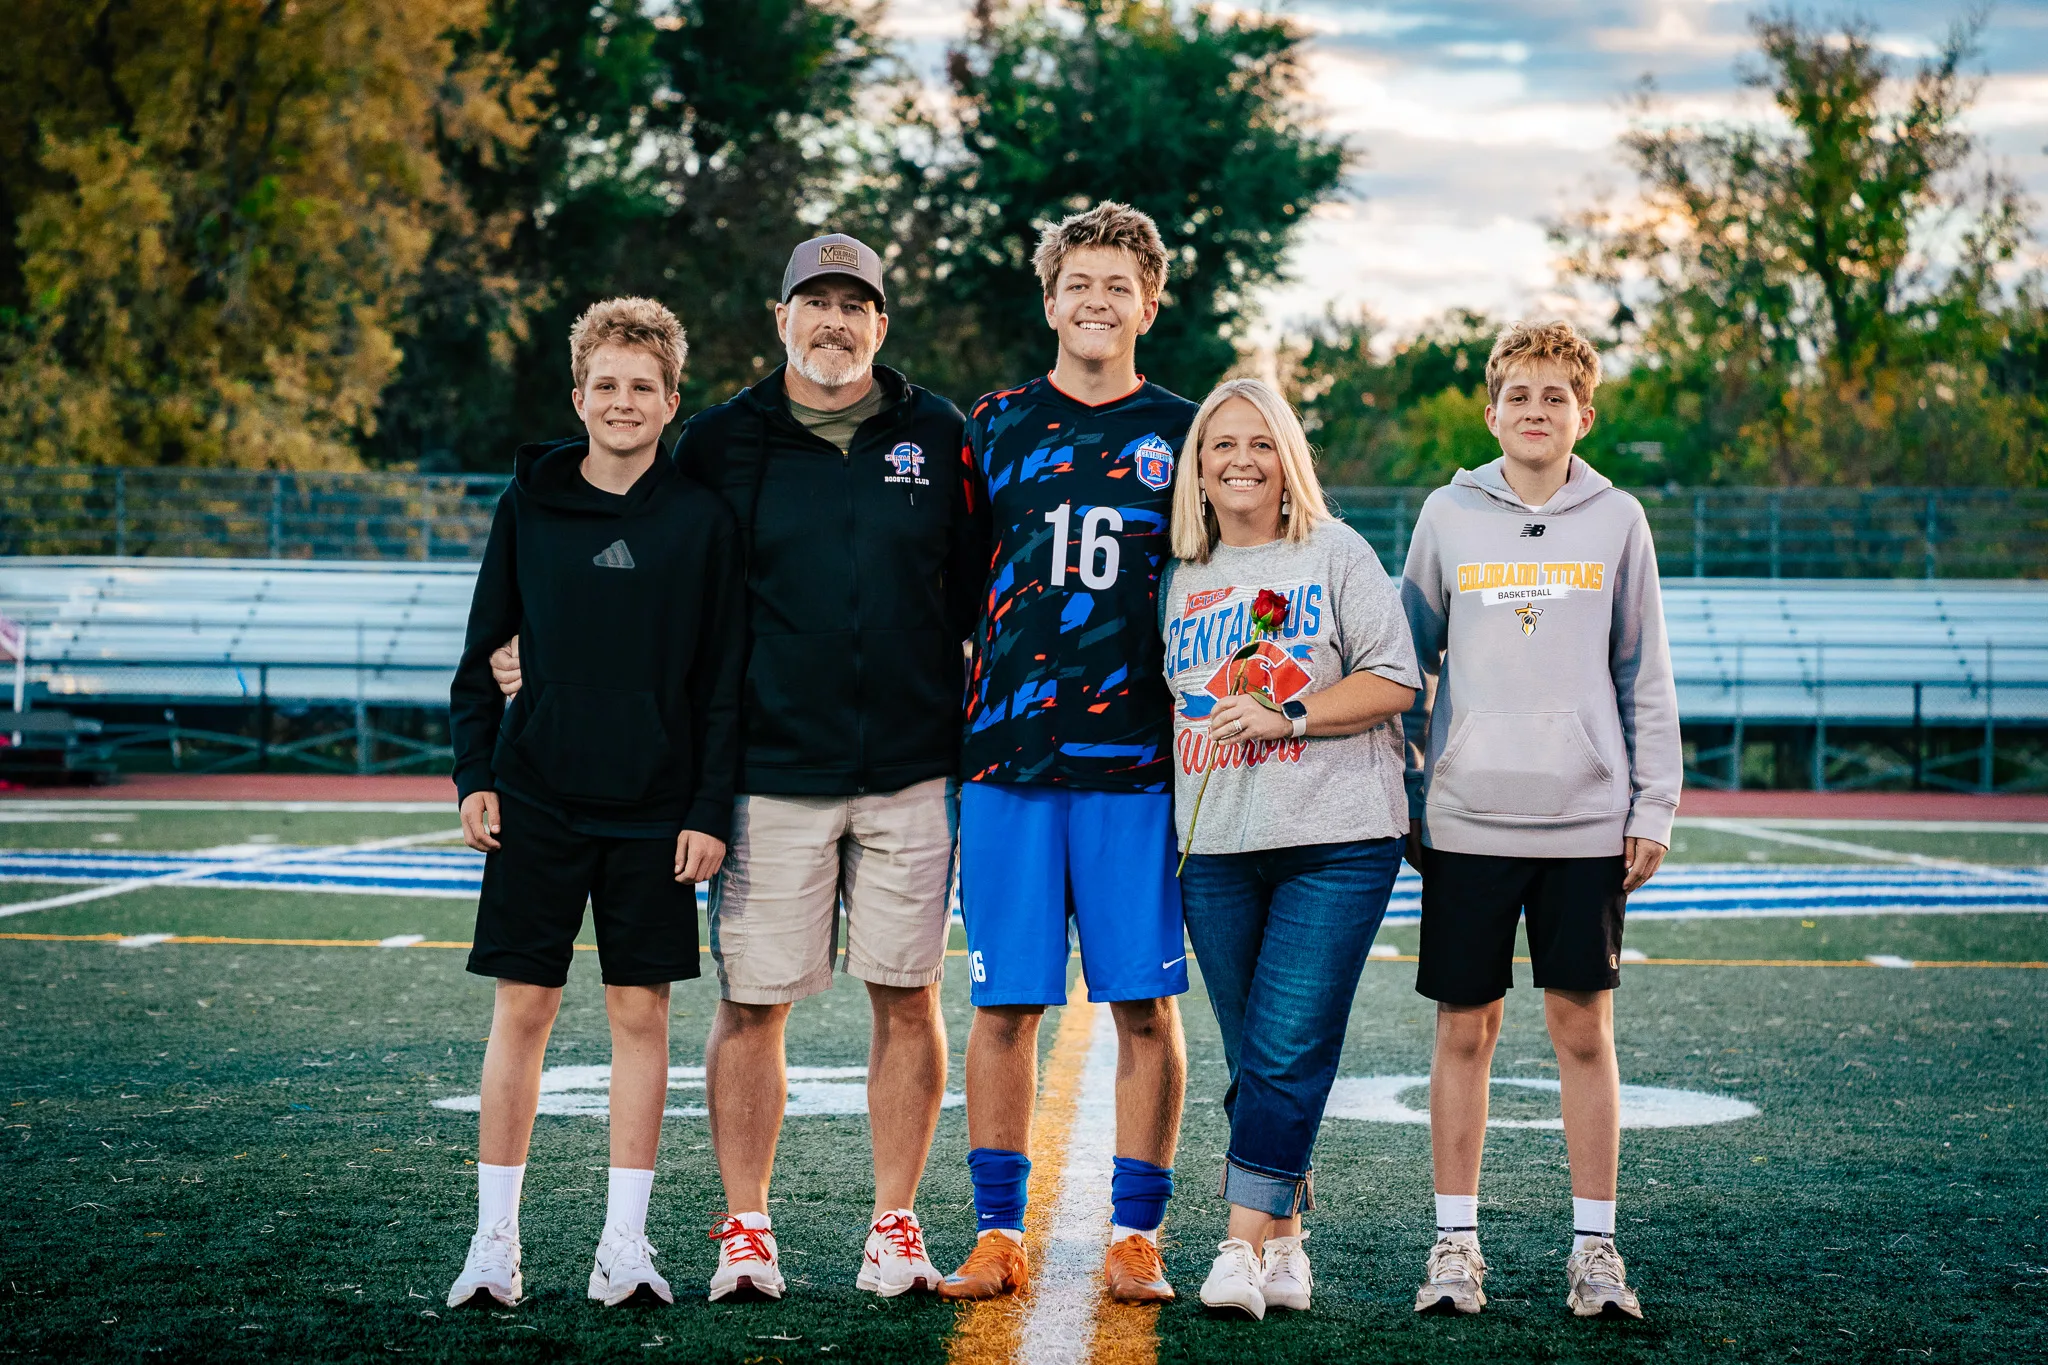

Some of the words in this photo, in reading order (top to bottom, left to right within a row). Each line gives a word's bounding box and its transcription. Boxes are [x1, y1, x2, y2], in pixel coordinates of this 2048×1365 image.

[1044, 503, 1124, 591] 16
[1458, 562, 1539, 593] COLORADO
[1542, 562, 1604, 591] TITANS
[1497, 588, 1552, 600] BASKETBALL
